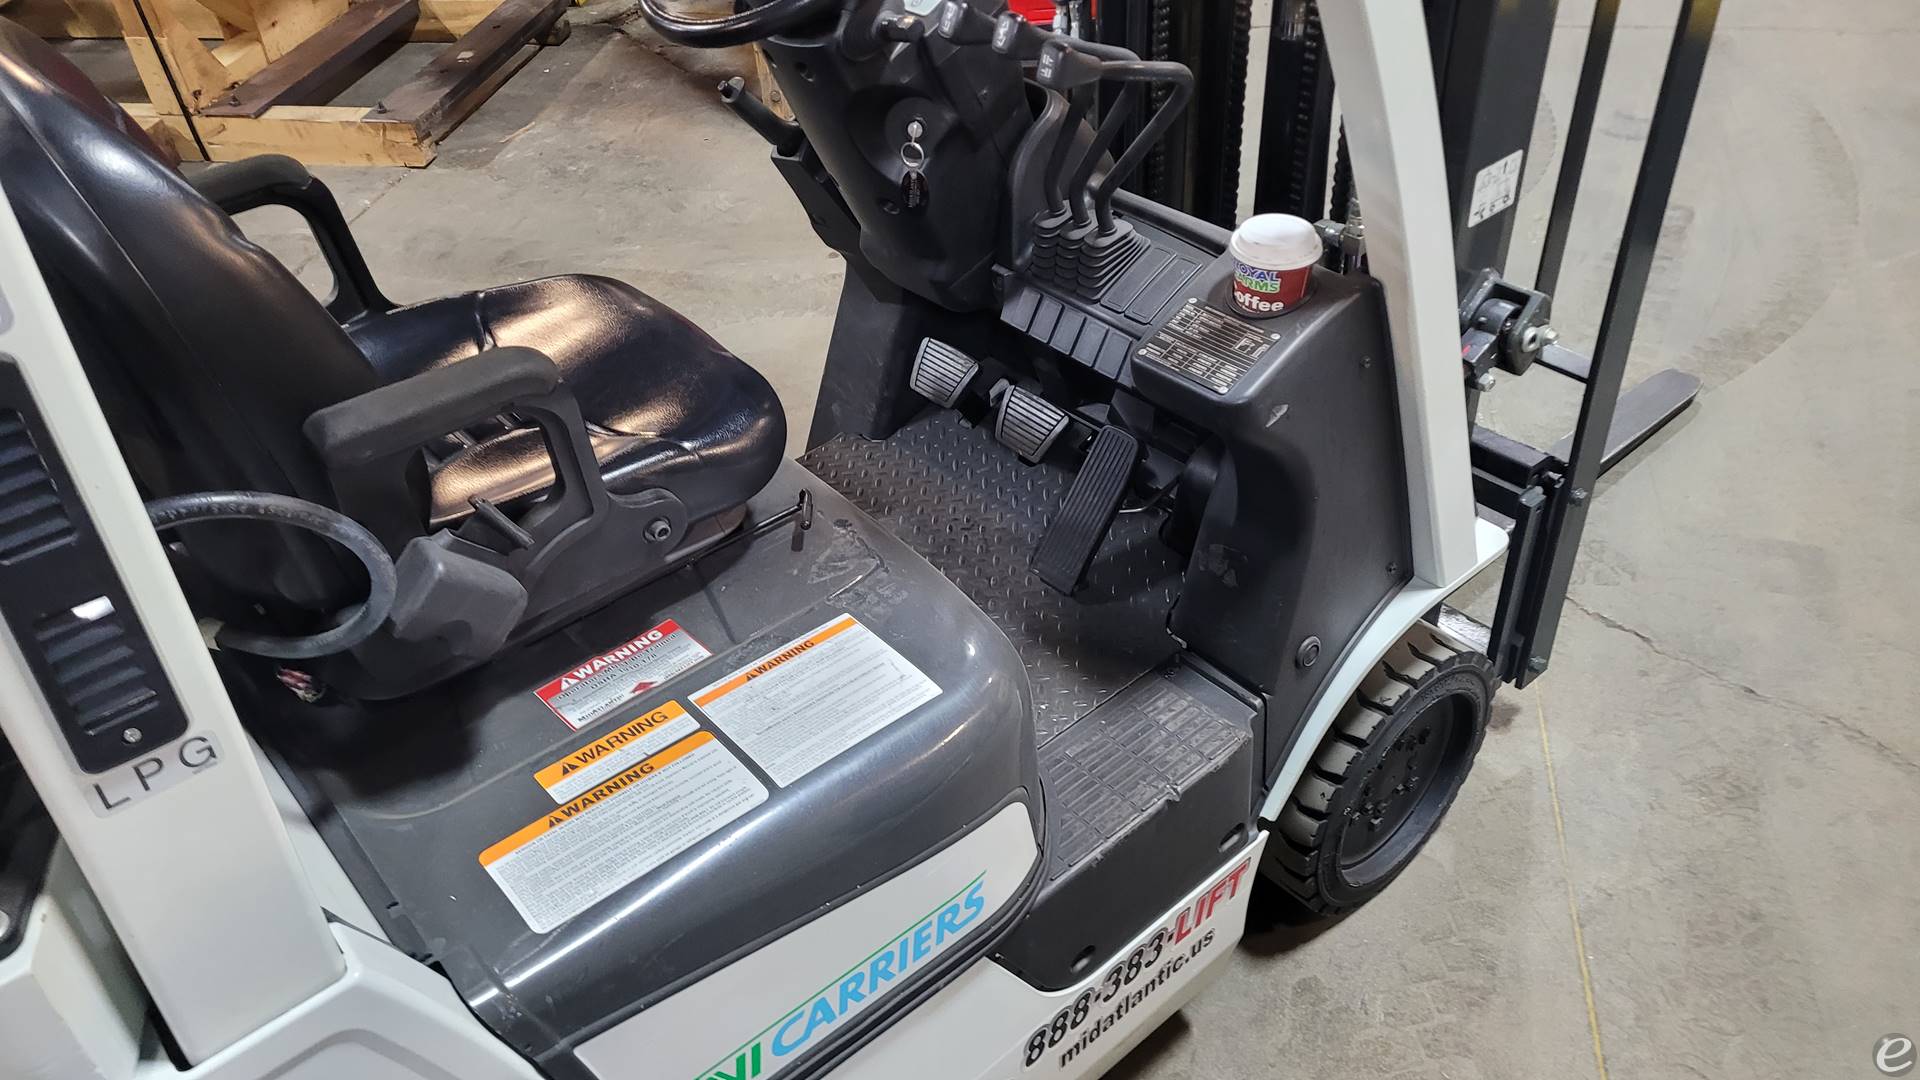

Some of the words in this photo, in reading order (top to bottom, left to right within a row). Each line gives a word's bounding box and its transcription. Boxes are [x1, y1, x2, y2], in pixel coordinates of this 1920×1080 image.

[1234, 291, 1284, 312] offee
[573, 630, 664, 680] WARNING
[754, 640, 815, 675] WARNING
[575, 711, 669, 764] WARNING
[93, 736, 217, 810] LPG
[560, 762, 655, 817] WARNING
[771, 880, 985, 1057] CARRIERS
[1024, 857, 1251, 1069] 888-383-LIFT
[1058, 928, 1216, 1068] midatlantic.us
